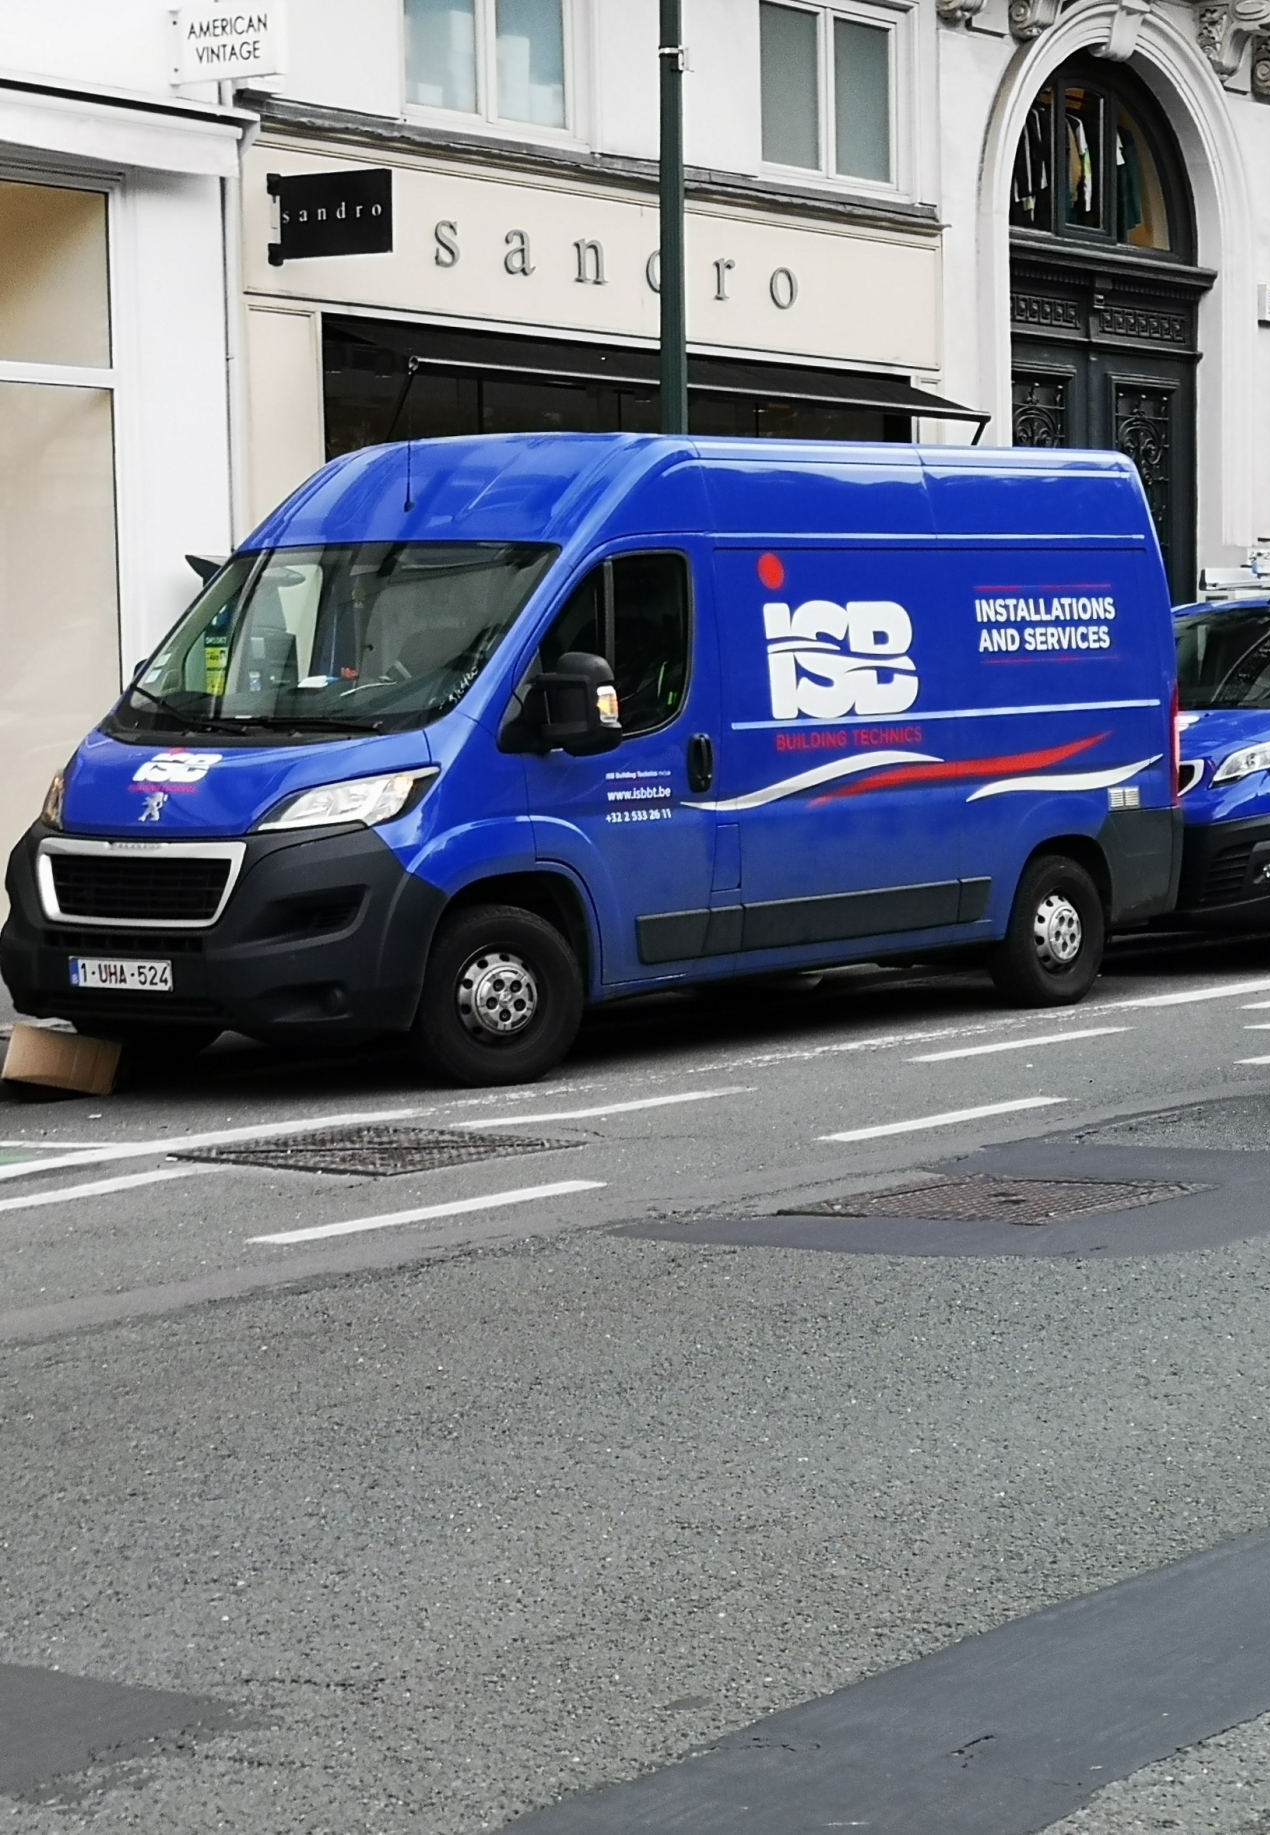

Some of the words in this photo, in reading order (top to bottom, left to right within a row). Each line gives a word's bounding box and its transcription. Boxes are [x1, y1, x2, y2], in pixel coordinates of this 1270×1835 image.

[187, 14, 267, 40] AMERICAN
[196, 40, 261, 64] VINTAGE
[282, 202, 382, 224] sandro
[974, 597, 1116, 622] INSTALLATIONS
[979, 628, 1021, 653] AND
[1024, 626, 1111, 651] SERVICES
[776, 730, 848, 751] BUILDING
[853, 726, 923, 746] TECHNICS
[606, 786, 671, 801] www.isbbt.be
[605, 812, 623, 823] +32
[623, 811, 631, 822] 2
[631, 810, 648, 821] 533
[648, 809, 660, 820] 26
[661, 808, 671, 819] 11
